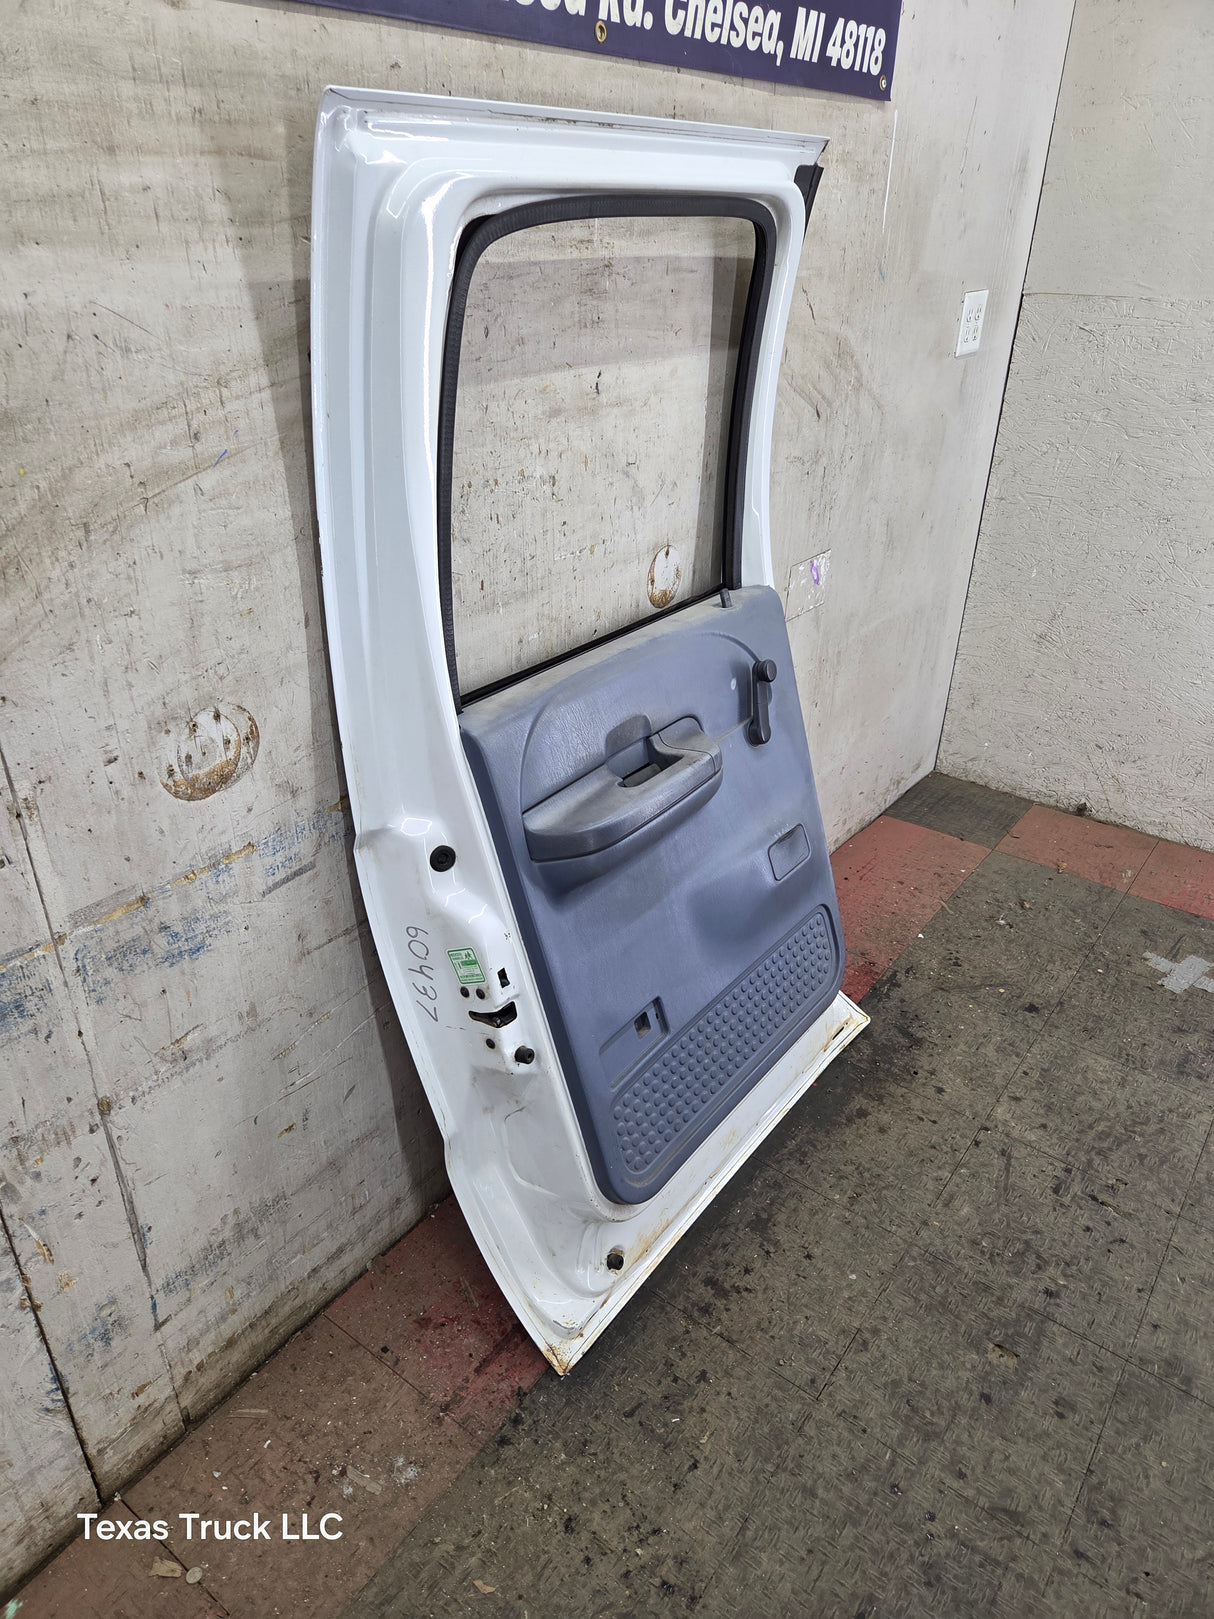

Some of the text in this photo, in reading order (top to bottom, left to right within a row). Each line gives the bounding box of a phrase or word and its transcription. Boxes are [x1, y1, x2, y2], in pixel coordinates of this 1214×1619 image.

[664, 0, 784, 66] Chelsea,
[790, 6, 826, 63] MI
[826, 17, 886, 76] 48118
[406, 926, 438, 1022] 60437
